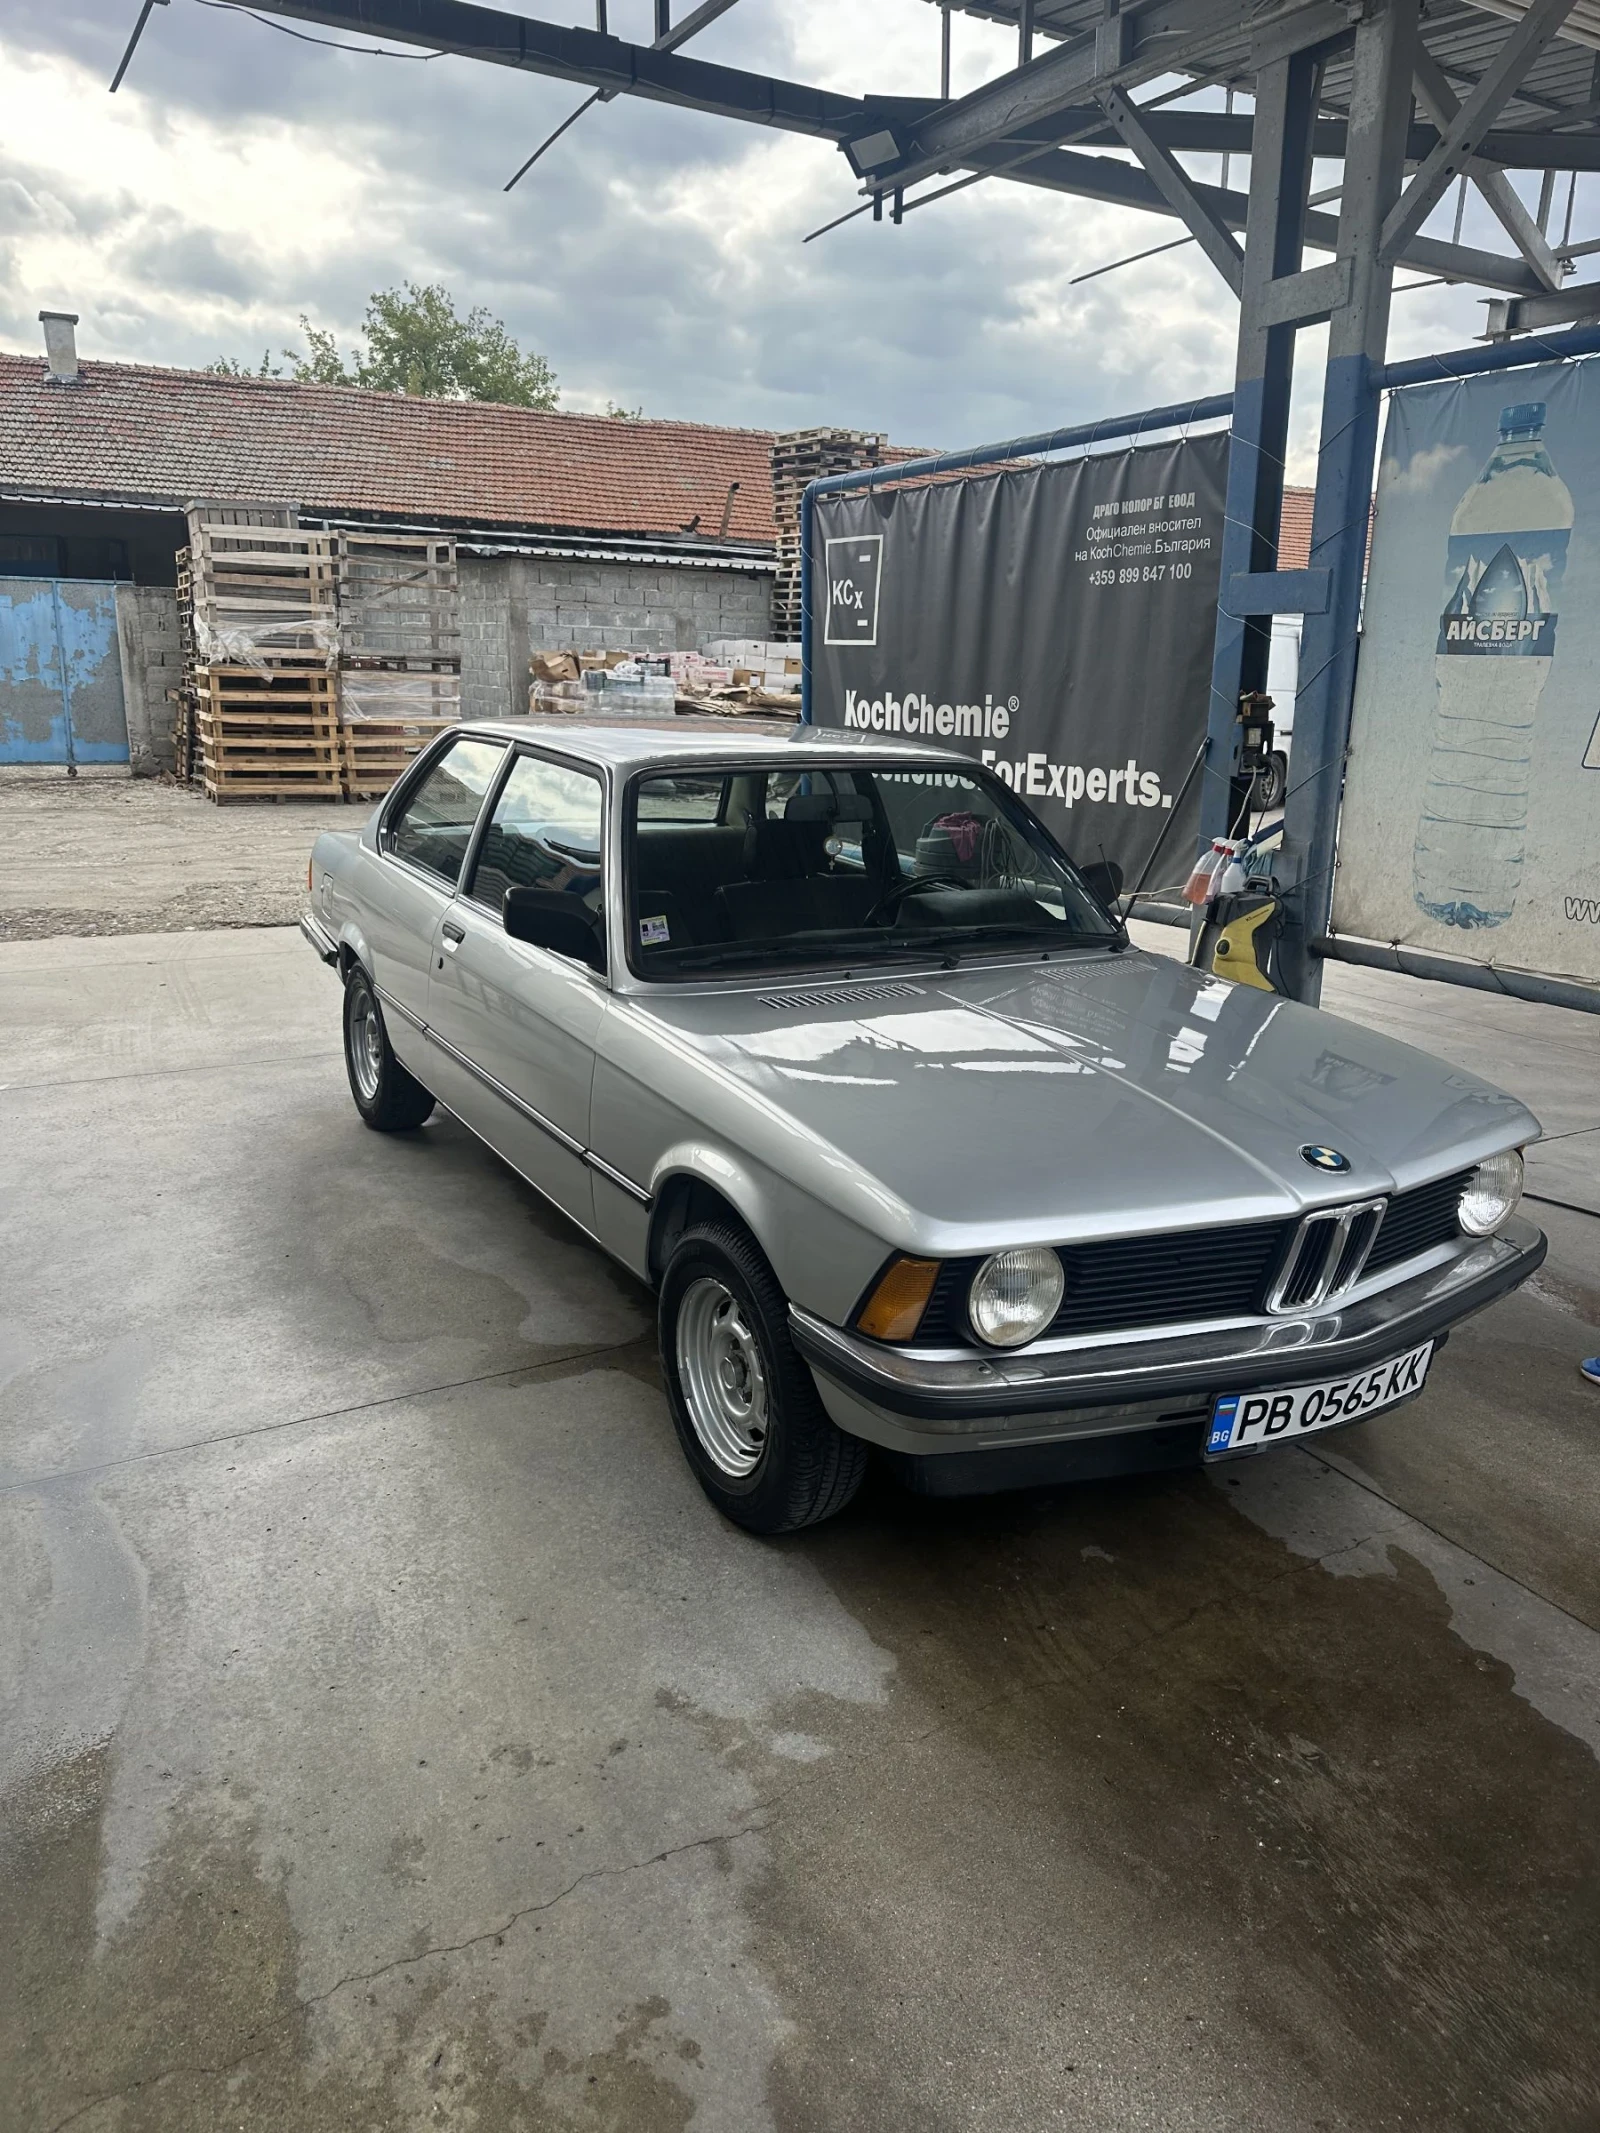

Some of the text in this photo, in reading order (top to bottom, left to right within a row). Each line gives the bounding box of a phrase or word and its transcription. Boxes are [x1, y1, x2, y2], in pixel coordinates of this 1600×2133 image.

[1092, 492, 1196, 520] ДРАГО КОЛОР БГ ЕООД
[1086, 517, 1202, 542] Официален вносител
[1075, 550, 1088, 562] на
[1088, 562, 1193, 586] +359 899 847 100
[1446, 616, 1546, 641] АЙСБЕРГ
[1236, 1347, 1428, 1441] PB 0565 KK
[1211, 1430, 1230, 1445] BG
